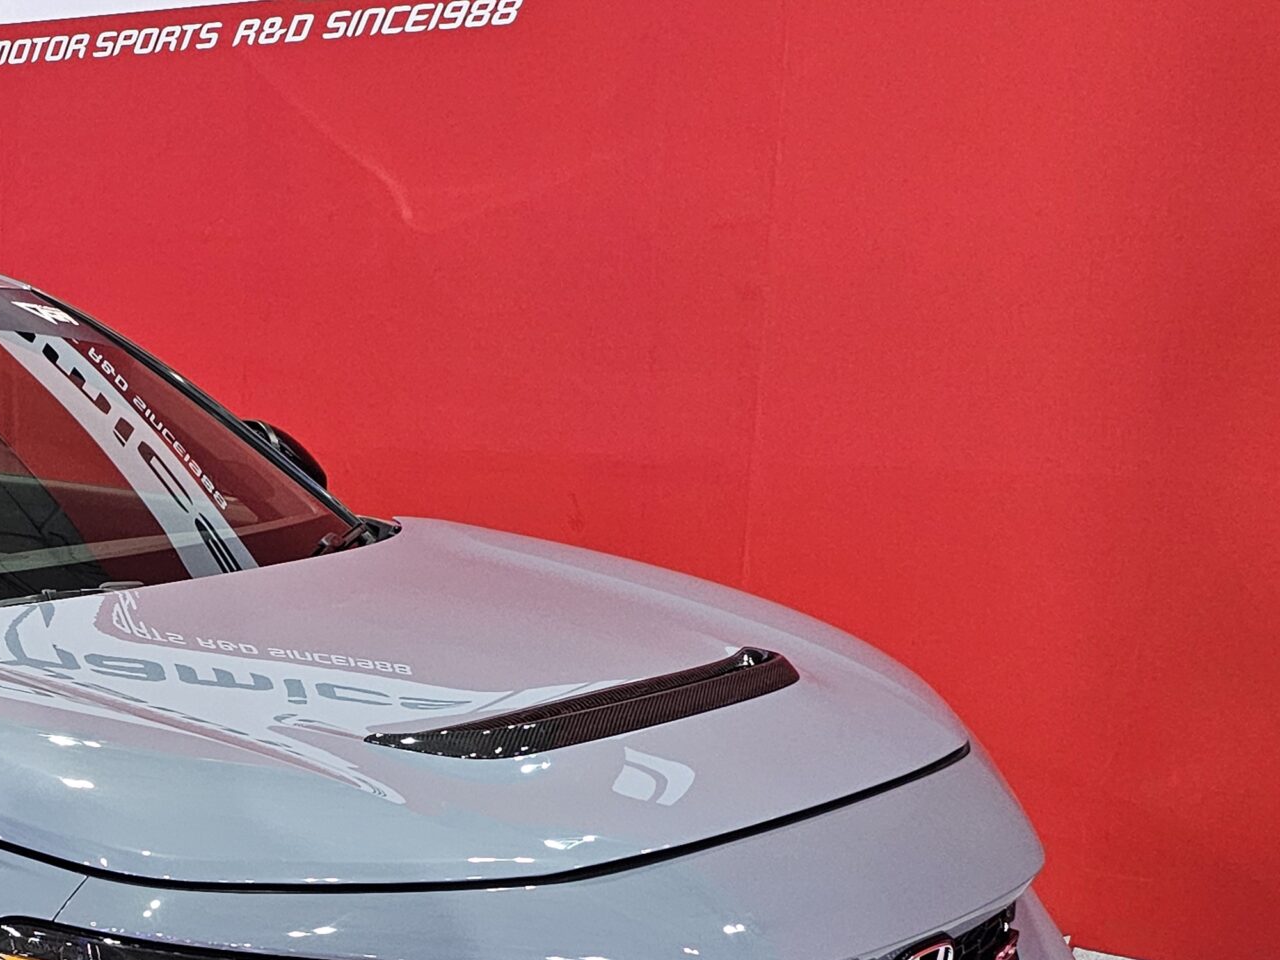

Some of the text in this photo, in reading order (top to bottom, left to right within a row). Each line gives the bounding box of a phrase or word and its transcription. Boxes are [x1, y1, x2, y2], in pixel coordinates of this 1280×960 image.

[92, 21, 223, 59] SPORTS
[231, 13, 315, 48] R&D
[322, 0, 522, 40] SINCE1988
